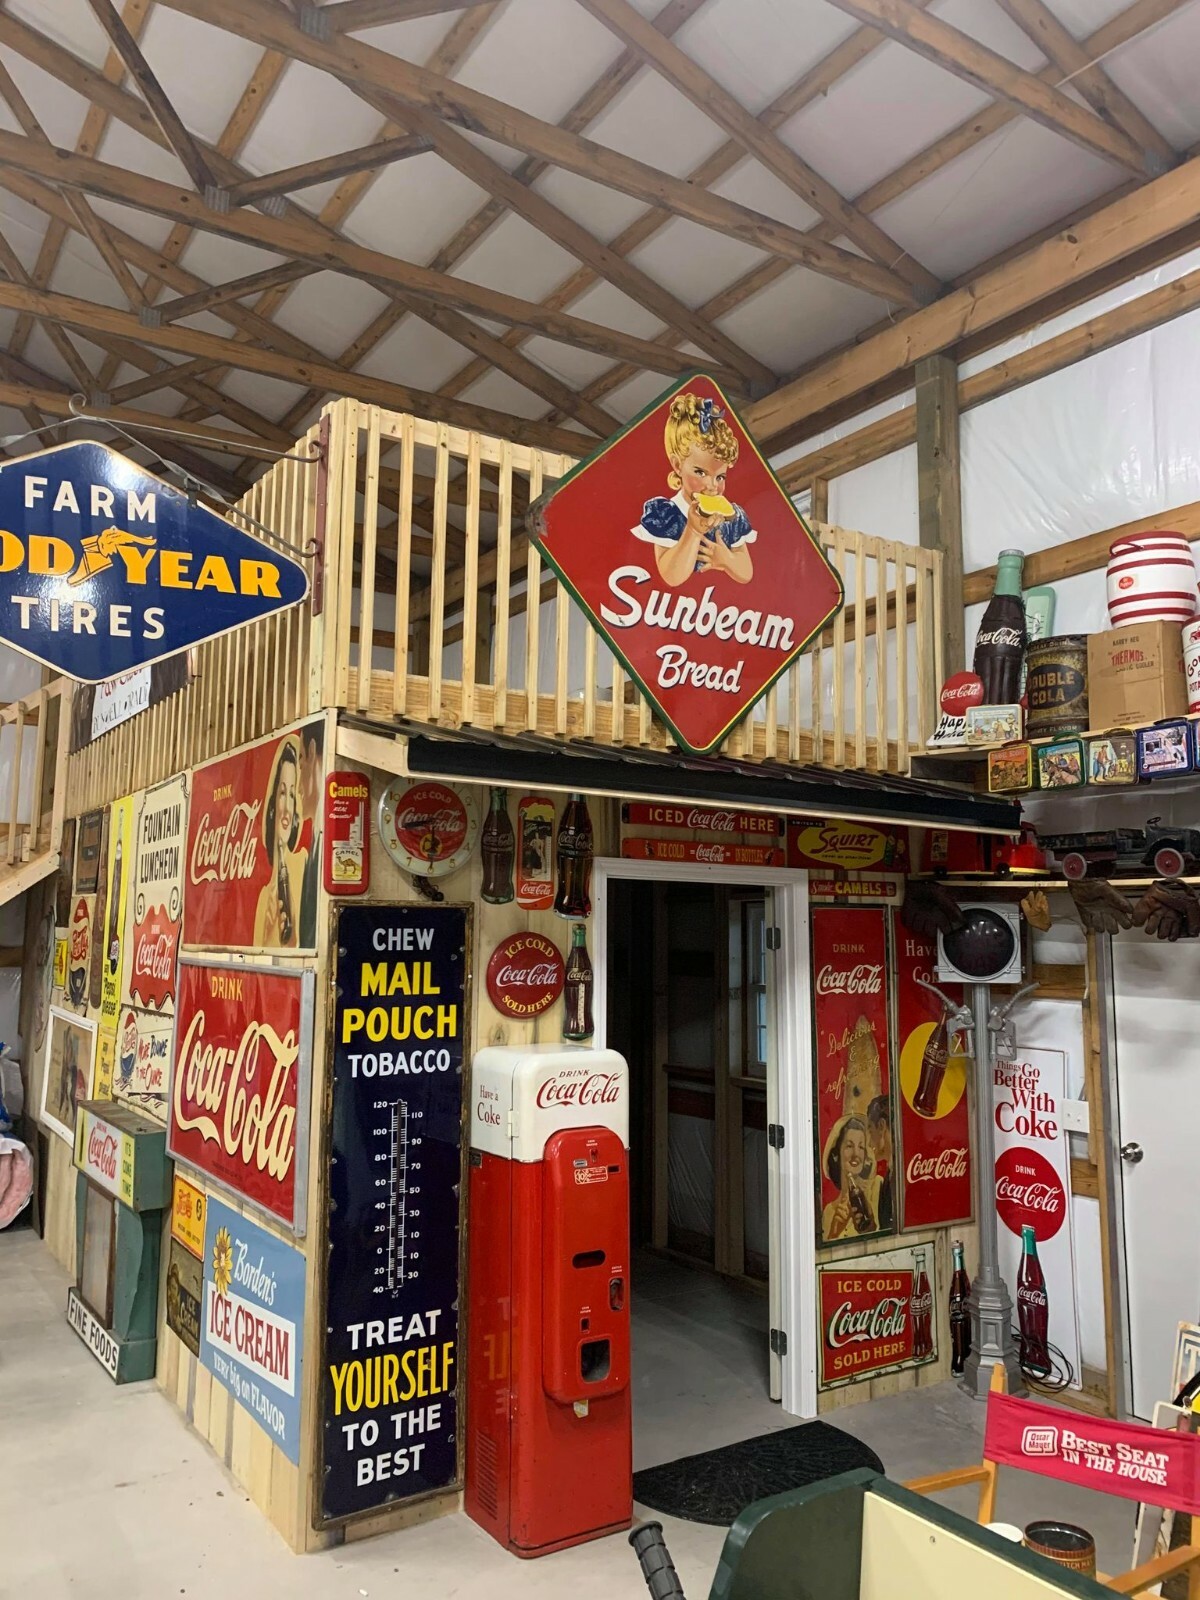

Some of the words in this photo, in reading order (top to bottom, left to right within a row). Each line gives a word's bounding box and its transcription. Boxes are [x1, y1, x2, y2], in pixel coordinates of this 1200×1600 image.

[24, 475, 156, 523] FARM
[11, 595, 165, 640] TIRES
[600, 565, 794, 651] Sunbeam
[656, 644, 745, 693] Bread
[1111, 649, 1144, 666] THERMOS
[941, 683, 981, 702] Coca-Cola
[1031, 688, 1066, 706] COLA
[213, 784, 232, 802] DRINK
[329, 781, 368, 798] Camels
[413, 791, 426, 801] ICE
[429, 791, 452, 803] COLD
[143, 803, 181, 844] FOUNTAIN
[398, 807, 463, 832] Coca-Cola
[649, 808, 684, 824] ICED
[687, 809, 737, 832] Coca-Cola
[740, 816, 775, 832] HERE
[190, 799, 262, 885] Coca-Cola
[657, 842, 668, 857] ICE
[669, 843, 685, 858] COLD
[140, 846, 179, 883] LUNCHEON
[520, 883, 552, 895] Coca-Cola
[835, 881, 882, 895] CAMELS
[372, 928, 434, 951] CHEW
[504, 940, 525, 959] ICE
[525, 938, 554, 957] COLD
[833, 943, 865, 953] DRINK
[135, 933, 174, 980] Coca-Cola
[361, 961, 440, 997] MAIL
[496, 963, 560, 987] Coca-Cola
[816, 964, 883, 995] Coca-Cola
[912, 966, 939, 984] Co
[211, 976, 243, 1002] DRINK
[502, 994, 526, 1013] SOLD
[527, 992, 553, 1013] HERE
[342, 1004, 457, 1043] POUCH
[826, 1020, 877, 1057] Delicious
[348, 1049, 450, 1078] TOBACCO
[559, 1069, 590, 1078] DRINK
[996, 1060, 1021, 1072] Things
[1021, 1063, 1040, 1079] Go
[480, 1085, 494, 1100] Have
[495, 1092, 499, 1101] a
[536, 1072, 623, 1109] Coca-Cola
[994, 1069, 1039, 1090] Better
[174, 1009, 299, 1182] Coca-Cola
[1011, 1088, 1056, 1113] With
[477, 1102, 501, 1125] Coke
[995, 1101, 1058, 1140] Coke
[906, 1148, 968, 1184] Coca-Cola
[1015, 1164, 1036, 1176] DRINK
[996, 1175, 1062, 1213] Coca-Cola
[233, 1239, 277, 1306] Borden's
[837, 1280, 862, 1293] ICE
[866, 1279, 902, 1292] COLD
[1017, 1286, 1046, 1306] Coca-Cola
[69, 1298, 87, 1336] FINE
[89, 1321, 117, 1371] FOODS
[210, 1291, 232, 1344] ICE
[234, 1304, 289, 1380] CREAM
[346, 1309, 442, 1351] TREAT
[828, 1296, 908, 1348] Coca-Cola
[834, 1350, 870, 1370] SOLD
[874, 1341, 905, 1359] HERE
[330, 1342, 453, 1416] YOURSELF
[229, 1361, 241, 1397] big
[241, 1379, 250, 1398] on
[250, 1381, 285, 1440] FLAVOR
[342, 1421, 379, 1451] TO
[390, 1404, 441, 1440] THE
[1030, 1433, 1049, 1441] Oscar
[1029, 1441, 1051, 1451] Mayer
[356, 1443, 425, 1486] BEST
[1061, 1449, 1080, 1465] IN
[1084, 1453, 1116, 1473] THE
[1117, 1462, 1168, 1486] HOUSE
